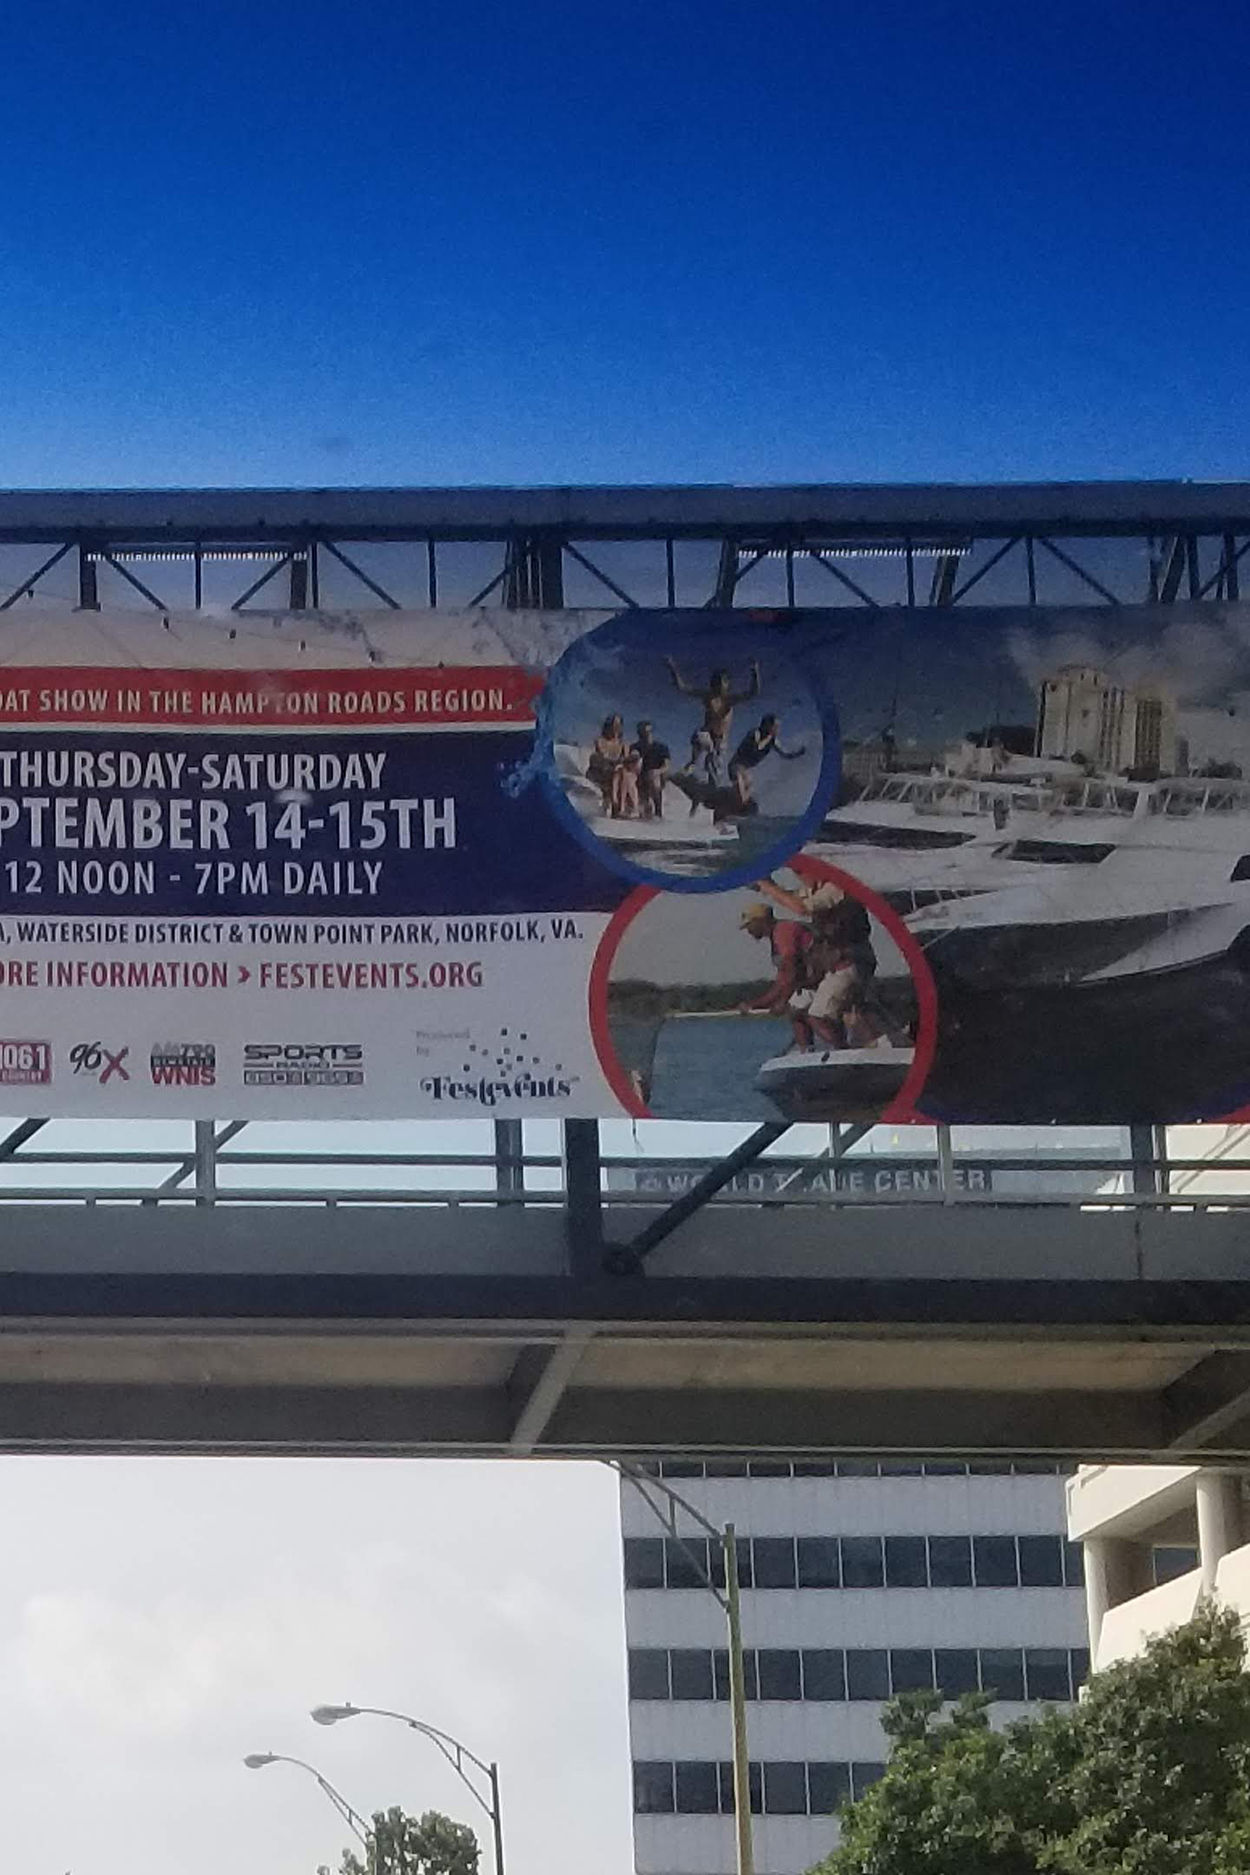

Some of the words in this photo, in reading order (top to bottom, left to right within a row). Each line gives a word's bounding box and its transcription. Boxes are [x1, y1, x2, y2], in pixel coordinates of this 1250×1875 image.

[39, 690, 108, 712] SHOW
[117, 690, 141, 713] IN
[150, 690, 193, 714] THE
[328, 690, 406, 713] ROADS
[415, 688, 513, 712] REGION.
[246, 797, 457, 850] 14-15TH
[4, 860, 42, 894] 12
[57, 861, 154, 895] NOON
[195, 862, 269, 895] 7PM
[283, 862, 383, 895] DAILY
[17, 922, 129, 944] WATERSIDE
[134, 922, 224, 944] DISTRICT
[228, 922, 243, 944] &
[248, 922, 308, 945] TOWN
[314, 922, 374, 945] POINT
[380, 922, 440, 946] PARK,
[446, 919, 546, 944] NORFOLK,
[550, 918, 584, 941] VA.
[48, 961, 228, 988] INFORMATION
[260, 961, 485, 989] FESTEVENTS.ORG
[244, 1044, 363, 1060] SPORTS
[151, 1067, 216, 1085] WNIS
[667, 1174, 764, 1192] WLD
